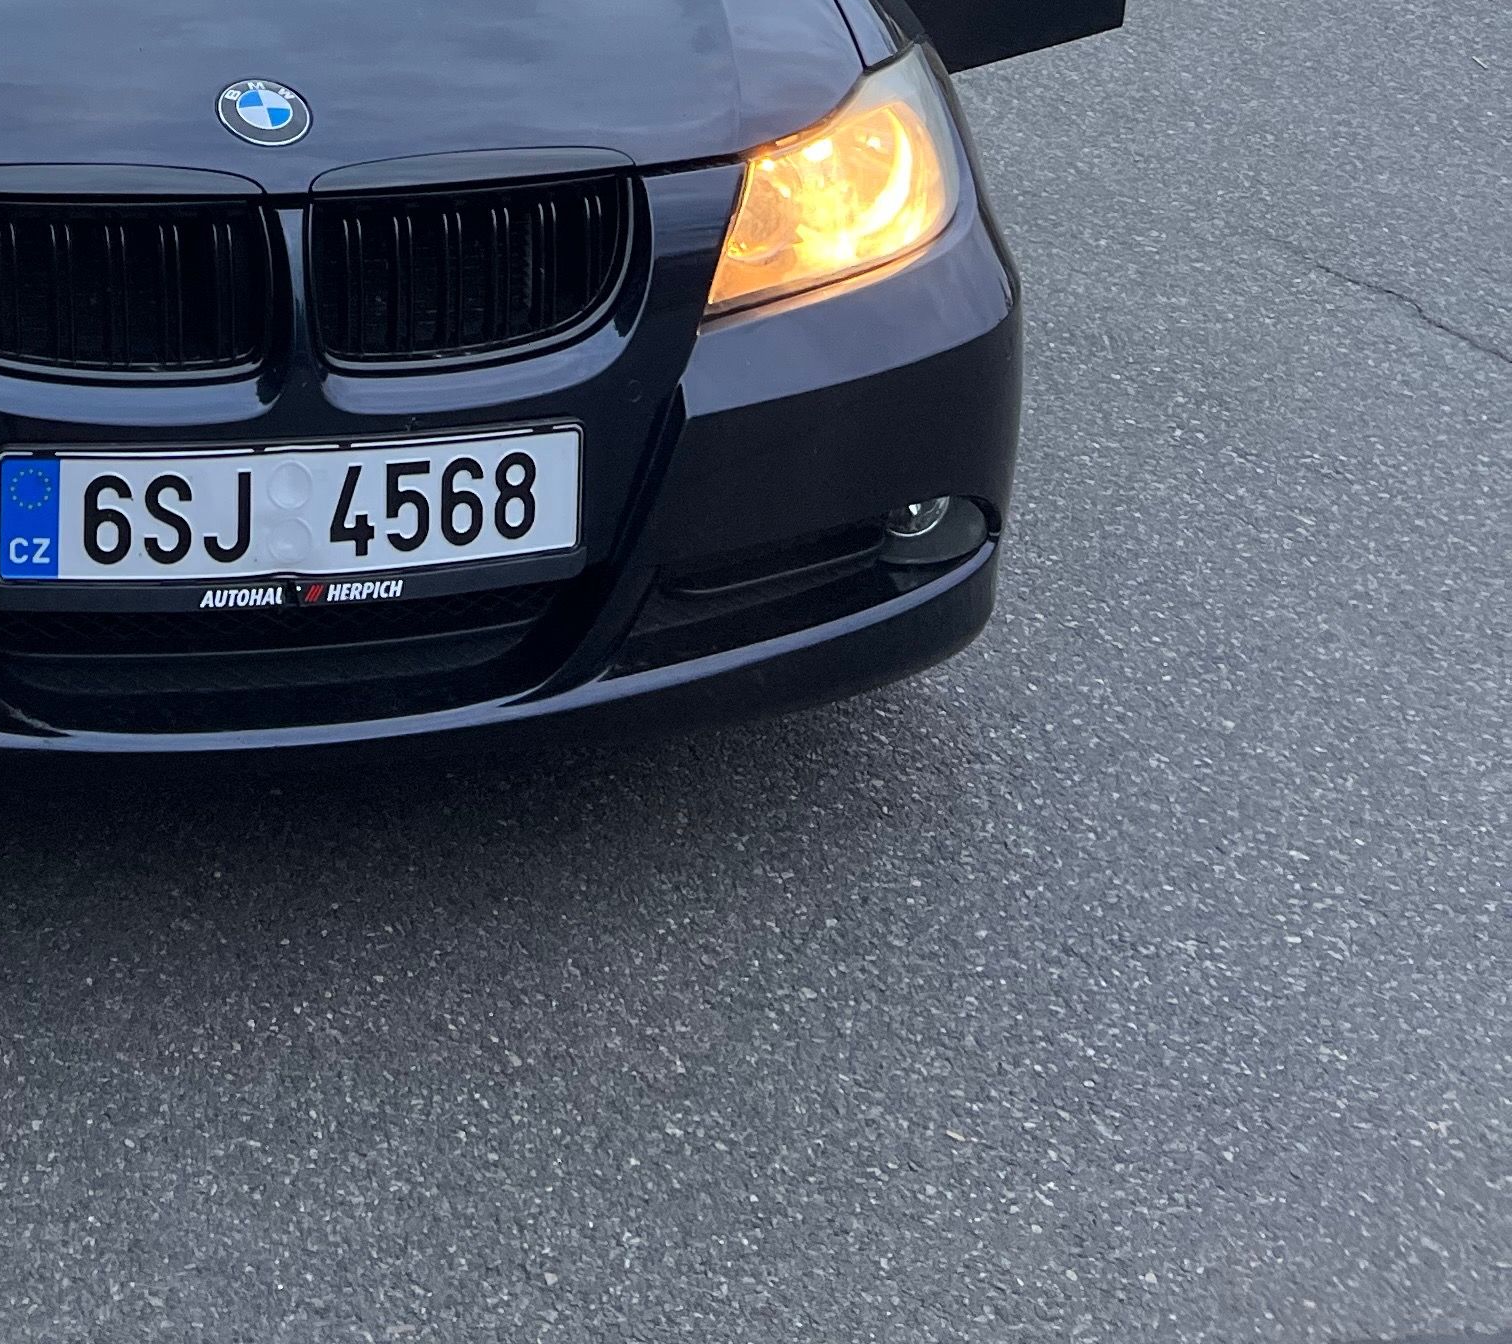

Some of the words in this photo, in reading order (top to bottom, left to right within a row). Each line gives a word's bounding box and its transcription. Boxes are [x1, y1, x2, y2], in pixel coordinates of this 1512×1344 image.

[224, 81, 296, 101] BMW
[83, 471, 252, 565] 6SJ
[329, 451, 536, 557] 4568
[9, 537, 51, 564] CZ
[326, 579, 404, 602] HERPICH
